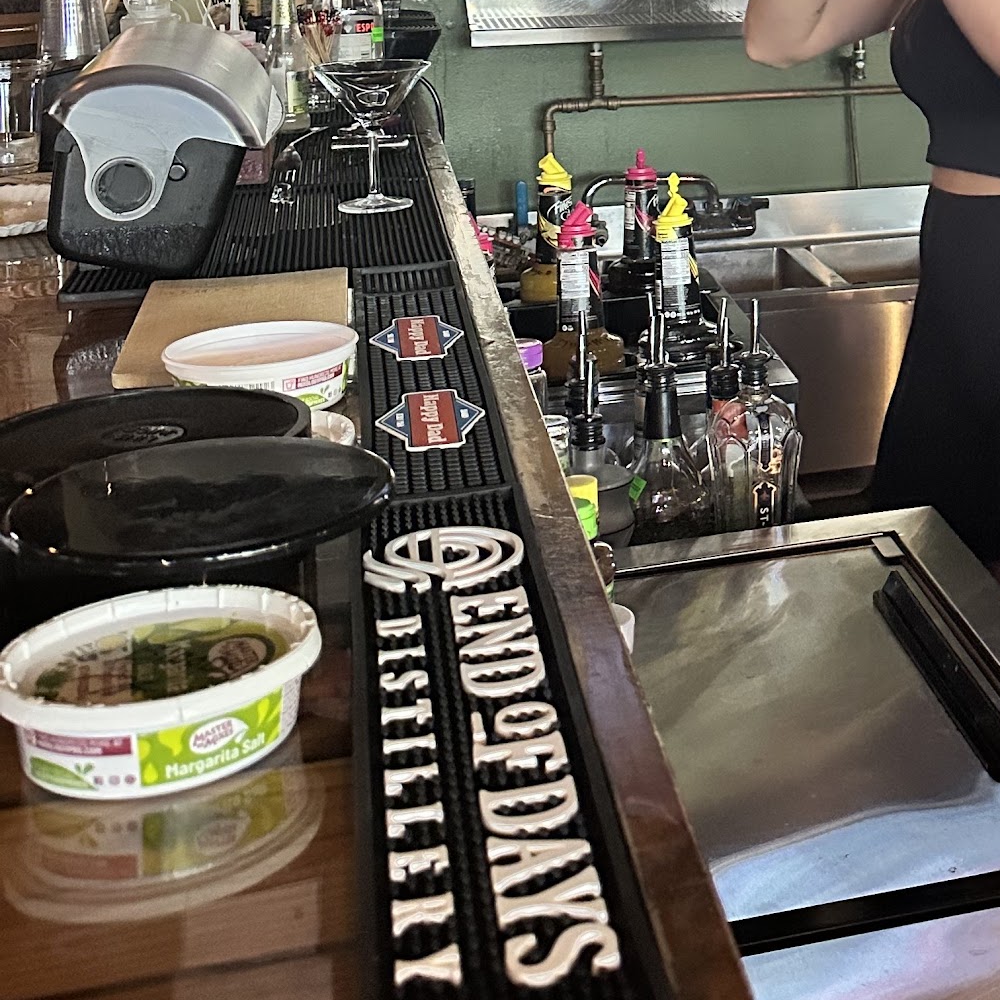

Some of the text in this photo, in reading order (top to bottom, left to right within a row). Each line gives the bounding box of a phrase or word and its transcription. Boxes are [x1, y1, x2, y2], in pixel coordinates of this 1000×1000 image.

[408, 318, 431, 356] Happy Dad
[419, 393, 448, 444] Happy Dad
[450, 585, 546, 698] END
[165, 732, 266, 780] Margarita Salt
[194, 719, 233, 743] MASTER
[375, 614, 463, 988] DISTILLERY
[478, 775, 622, 989] DAYS
